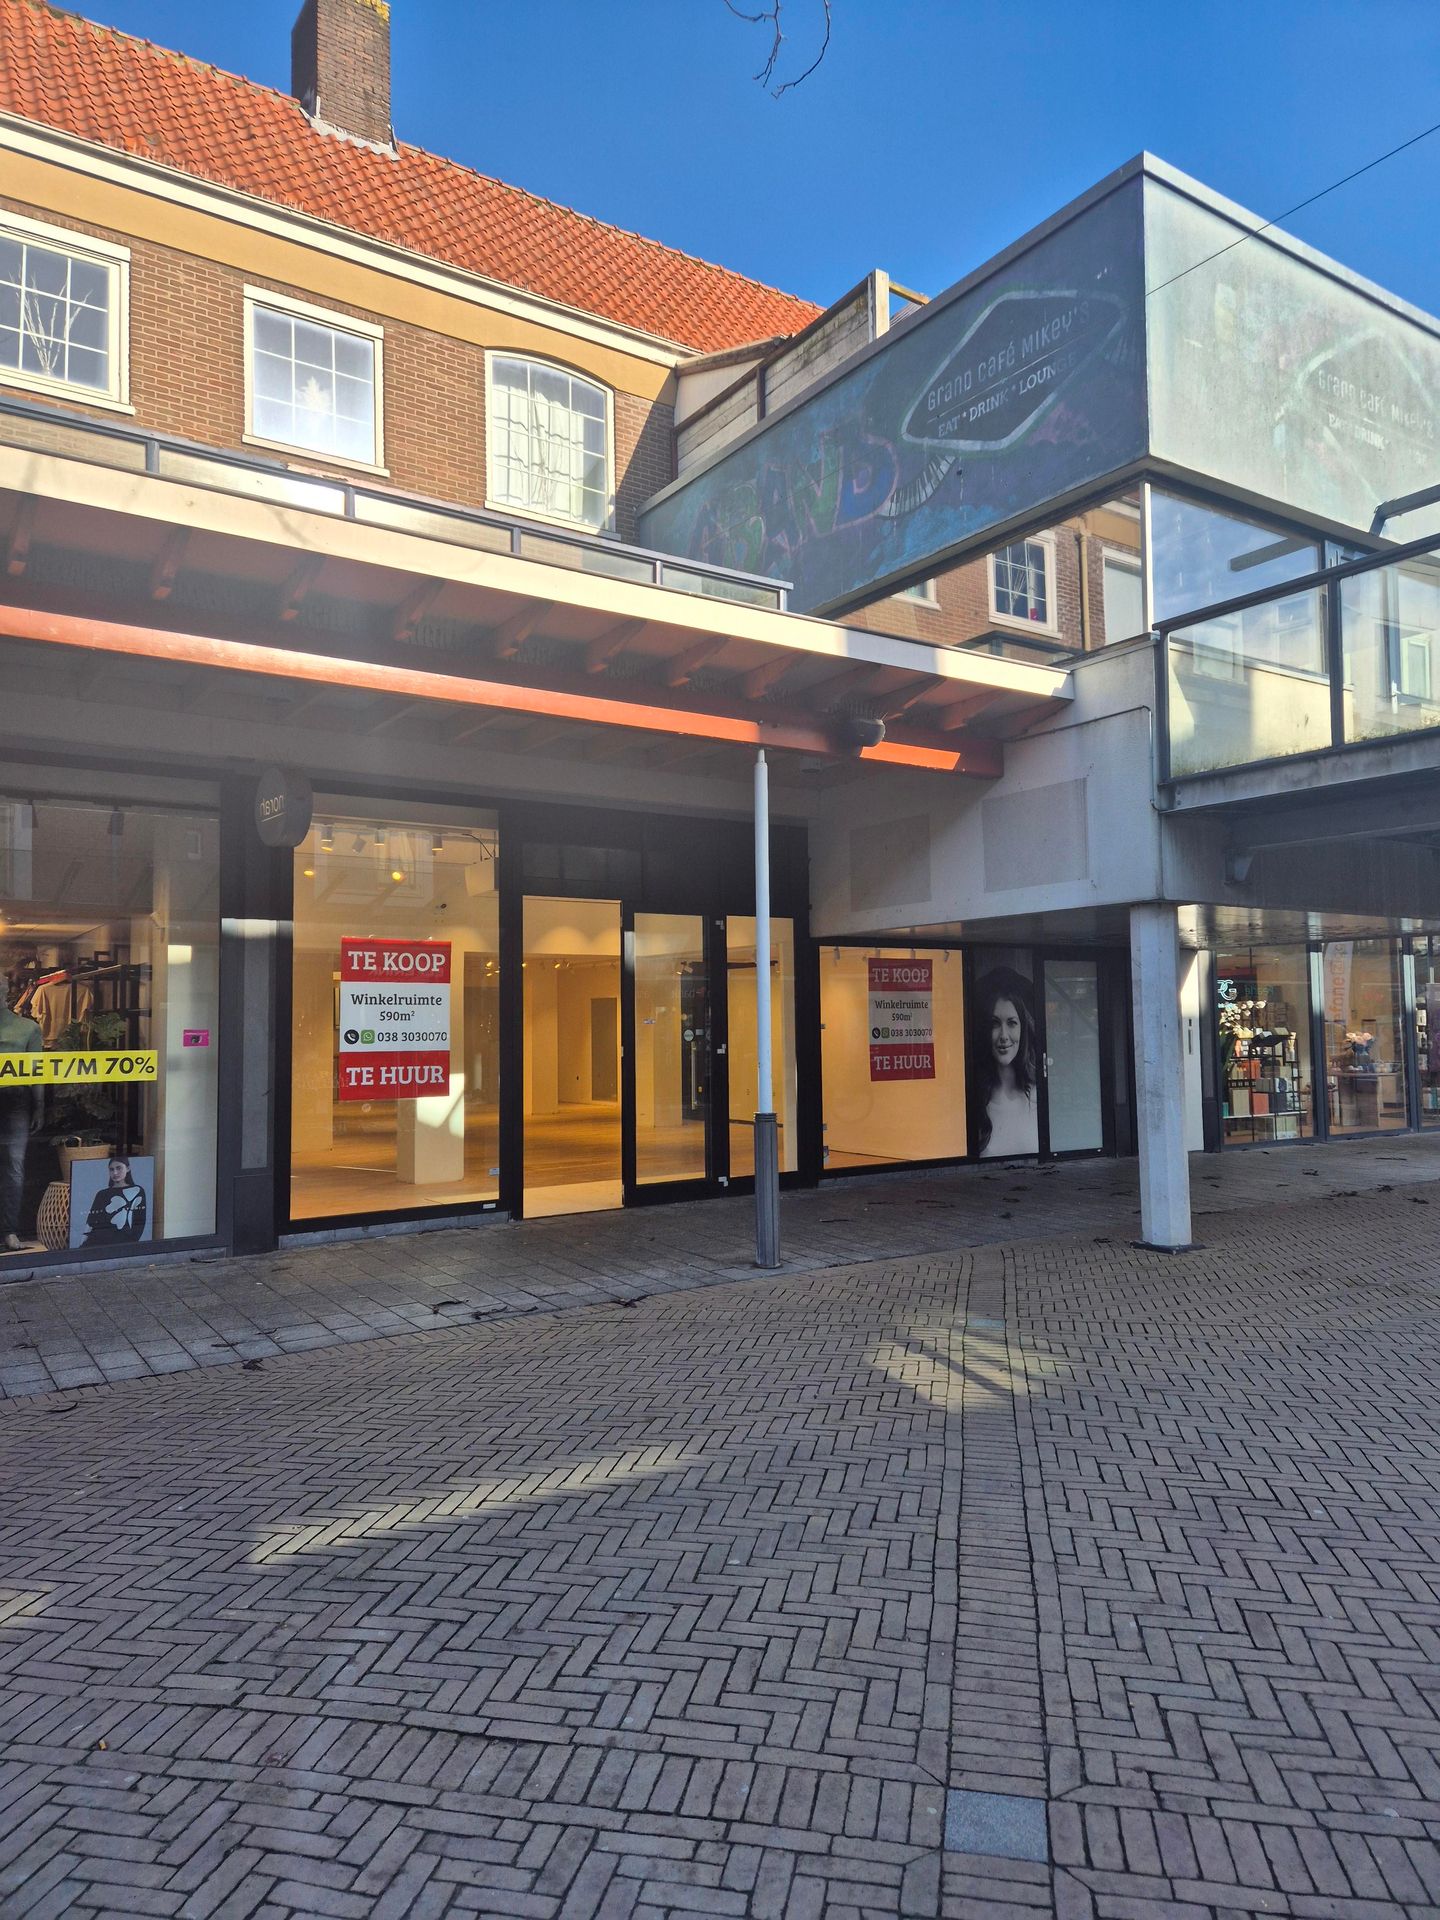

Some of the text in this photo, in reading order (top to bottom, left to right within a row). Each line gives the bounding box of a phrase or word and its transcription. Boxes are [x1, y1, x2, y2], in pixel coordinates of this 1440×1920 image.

[938, 416, 960, 438] EAT
[968, 388, 1009, 422] DRINK
[348, 950, 377, 970] TE
[382, 952, 446, 972] KOOP
[872, 968, 930, 983] TE KOOP
[350, 993, 442, 1006] Winkelruimte
[875, 1000, 929, 1009] Winkelruimte
[379, 1010, 415, 1021] 590m²
[377, 1031, 448, 1042] 038 3030070
[890, 1028, 904, 1037] 038
[50, 1057, 98, 1078] T/M
[105, 1056, 155, 1076] 70%
[874, 1054, 932, 1070] TE HUUR
[346, 1065, 444, 1086] TE HUUR
